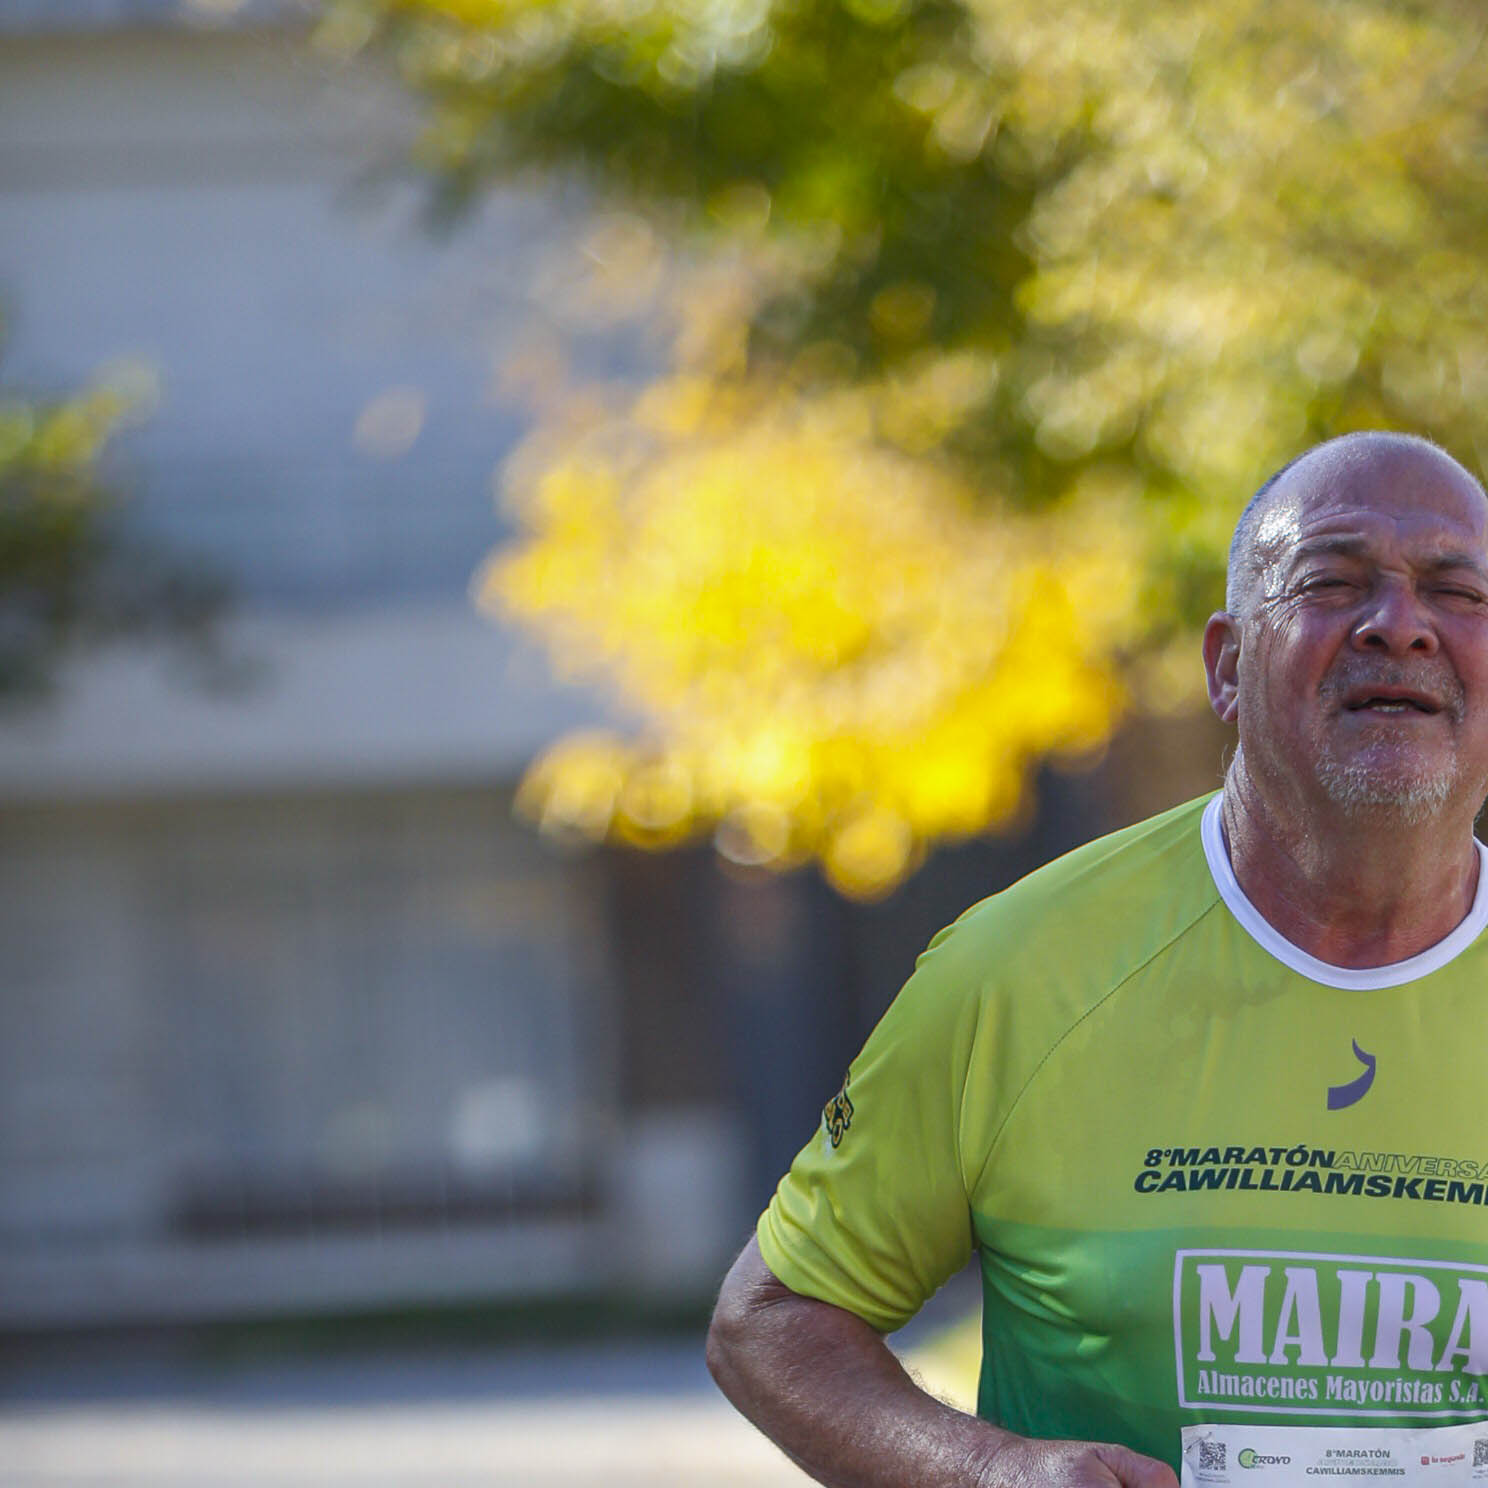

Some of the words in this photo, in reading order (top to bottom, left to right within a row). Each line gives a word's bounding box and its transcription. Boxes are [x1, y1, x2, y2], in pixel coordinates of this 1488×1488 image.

[1197, 1369, 1318, 1400] Almacenes
[1326, 1375, 1443, 1405] Mayoristas
[1449, 1379, 1485, 1404] S.A.
